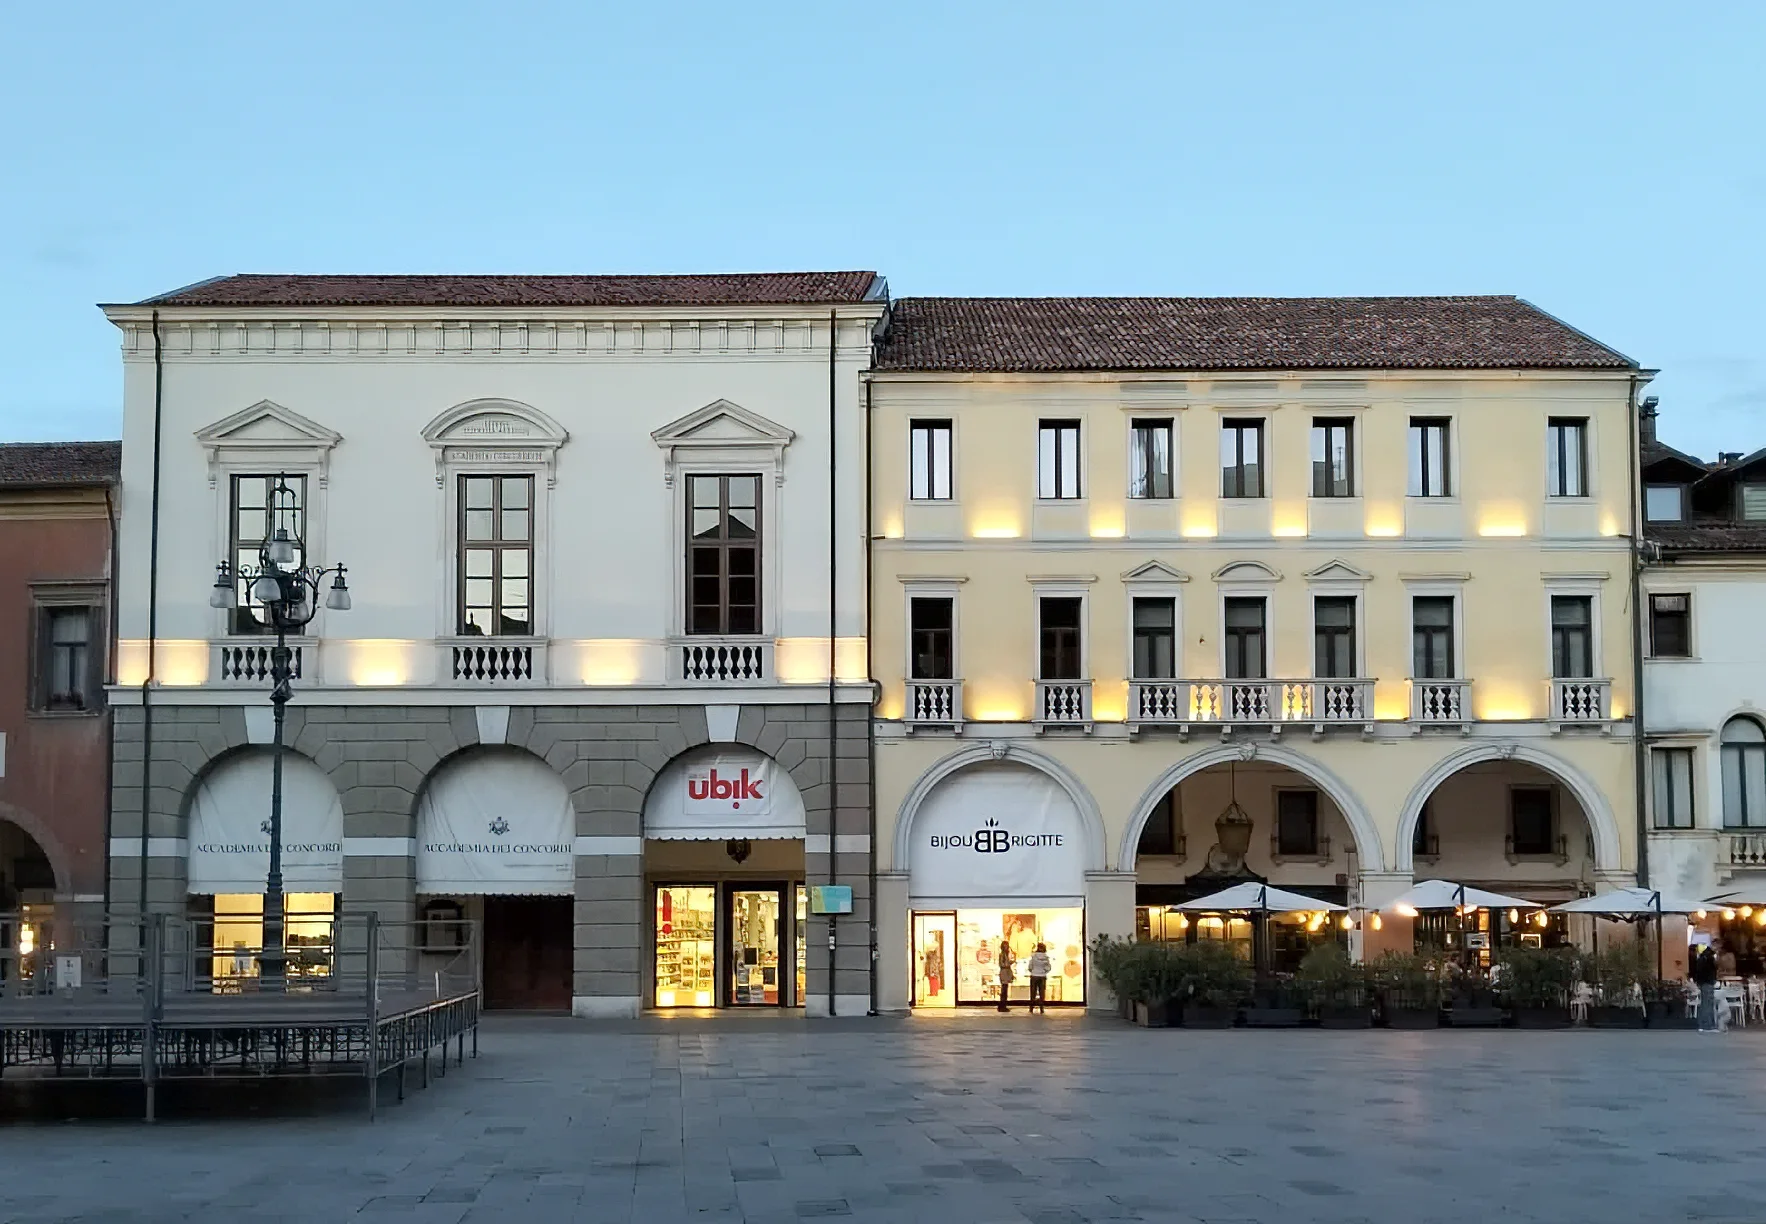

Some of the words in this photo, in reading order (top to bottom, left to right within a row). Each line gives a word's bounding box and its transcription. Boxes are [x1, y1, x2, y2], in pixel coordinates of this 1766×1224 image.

[688, 768, 764, 809] ubik
[424, 843, 490, 853] ACCADEMIA
[931, 835, 972, 849] BIJOU
[196, 844, 263, 853] ACCADEMIA
